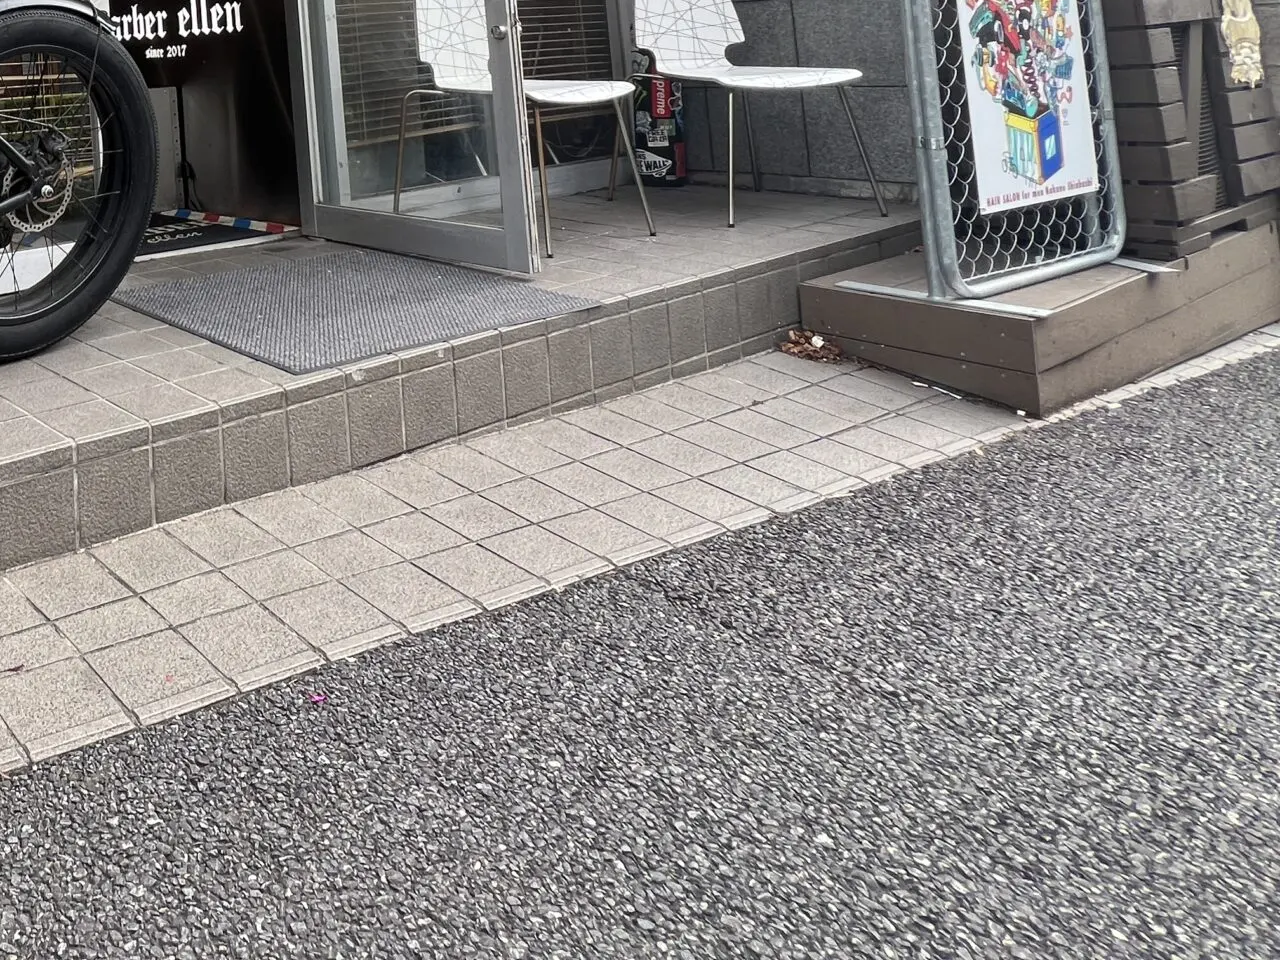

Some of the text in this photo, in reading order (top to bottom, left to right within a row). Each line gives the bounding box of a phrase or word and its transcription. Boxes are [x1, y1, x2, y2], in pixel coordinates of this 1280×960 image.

[110, 2, 168, 41] arber
[144, 43, 187, 59] since 2017
[651, 79, 666, 115] preme
[644, 158, 669, 172] WALL
[1002, 192, 1021, 203] SALON
[1021, 190, 1031, 200] for
[1032, 189, 1044, 198] men
